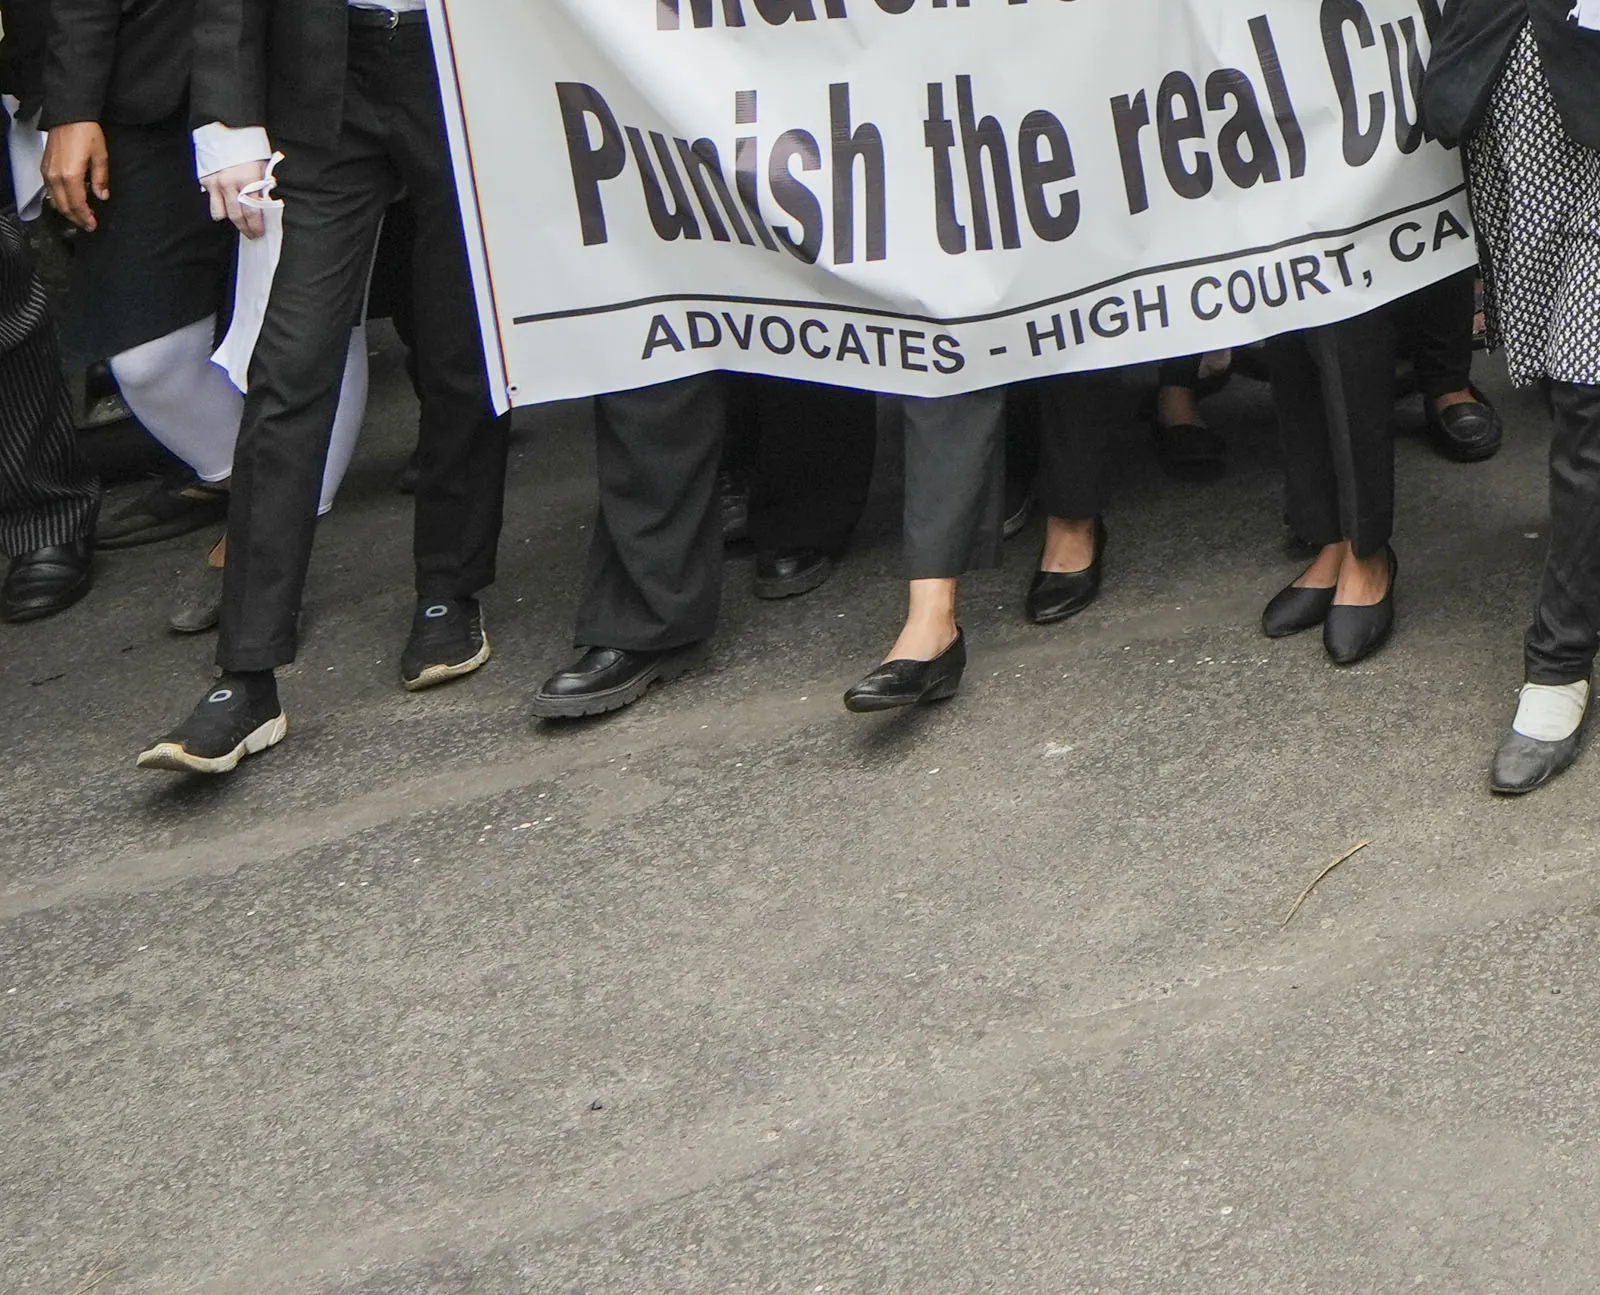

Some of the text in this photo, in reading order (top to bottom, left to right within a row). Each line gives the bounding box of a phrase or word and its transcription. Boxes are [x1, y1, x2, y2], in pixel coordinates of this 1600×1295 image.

[555, 75, 887, 266] Punish
[924, 74, 1081, 256] the
[1109, 14, 1308, 216] real
[640, 311, 966, 375] ADVOCATES
[1026, 285, 1170, 357] HIGH
[1190, 242, 1372, 326] COURT,
